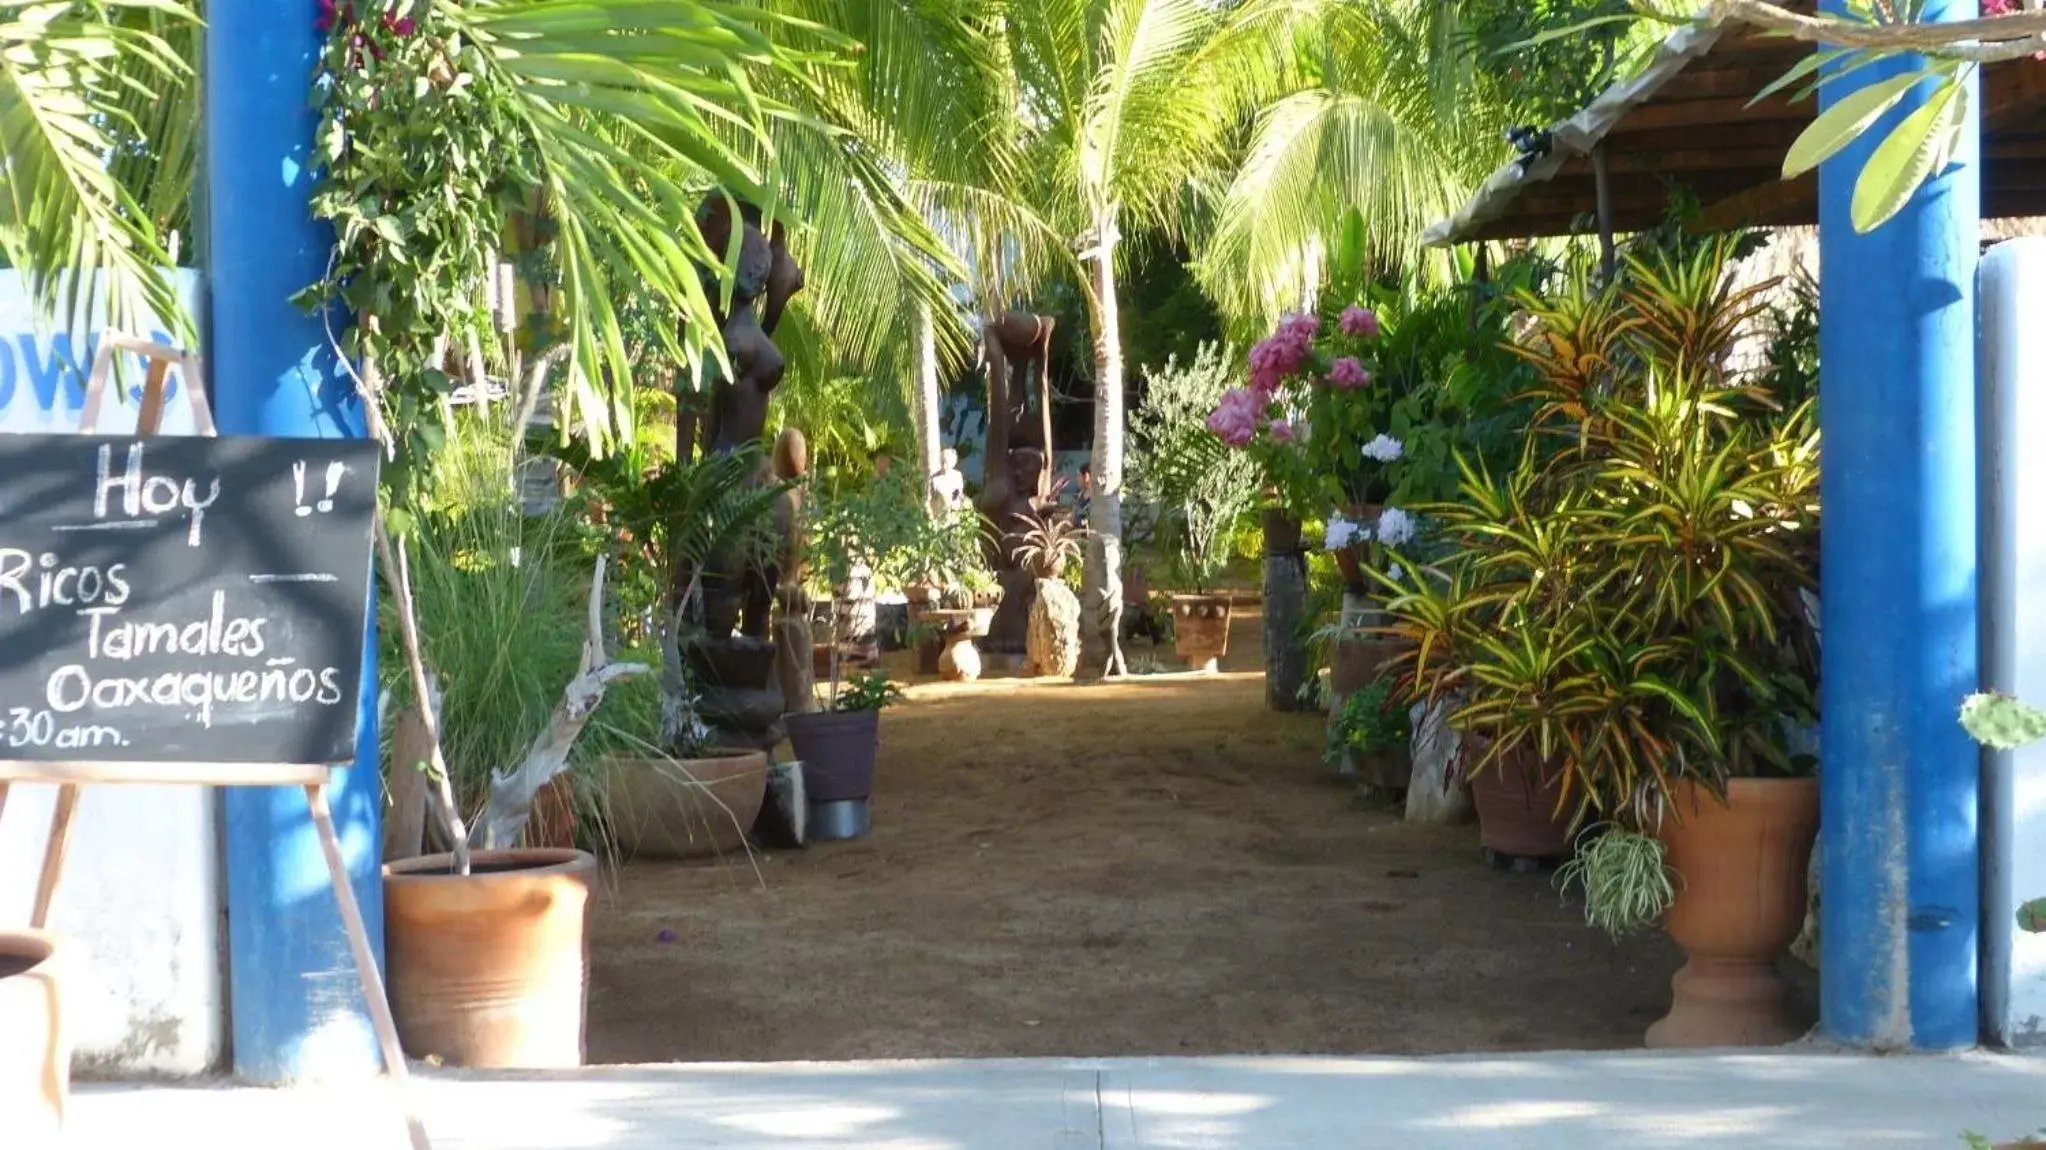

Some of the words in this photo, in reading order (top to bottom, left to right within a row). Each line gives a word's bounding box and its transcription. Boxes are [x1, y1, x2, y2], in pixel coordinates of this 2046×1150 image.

[94, 442, 221, 547] Hoy
[0, 548, 130, 614] Ricos
[77, 590, 266, 659] Tamales
[46, 657, 341, 729] Oaxaqueños
